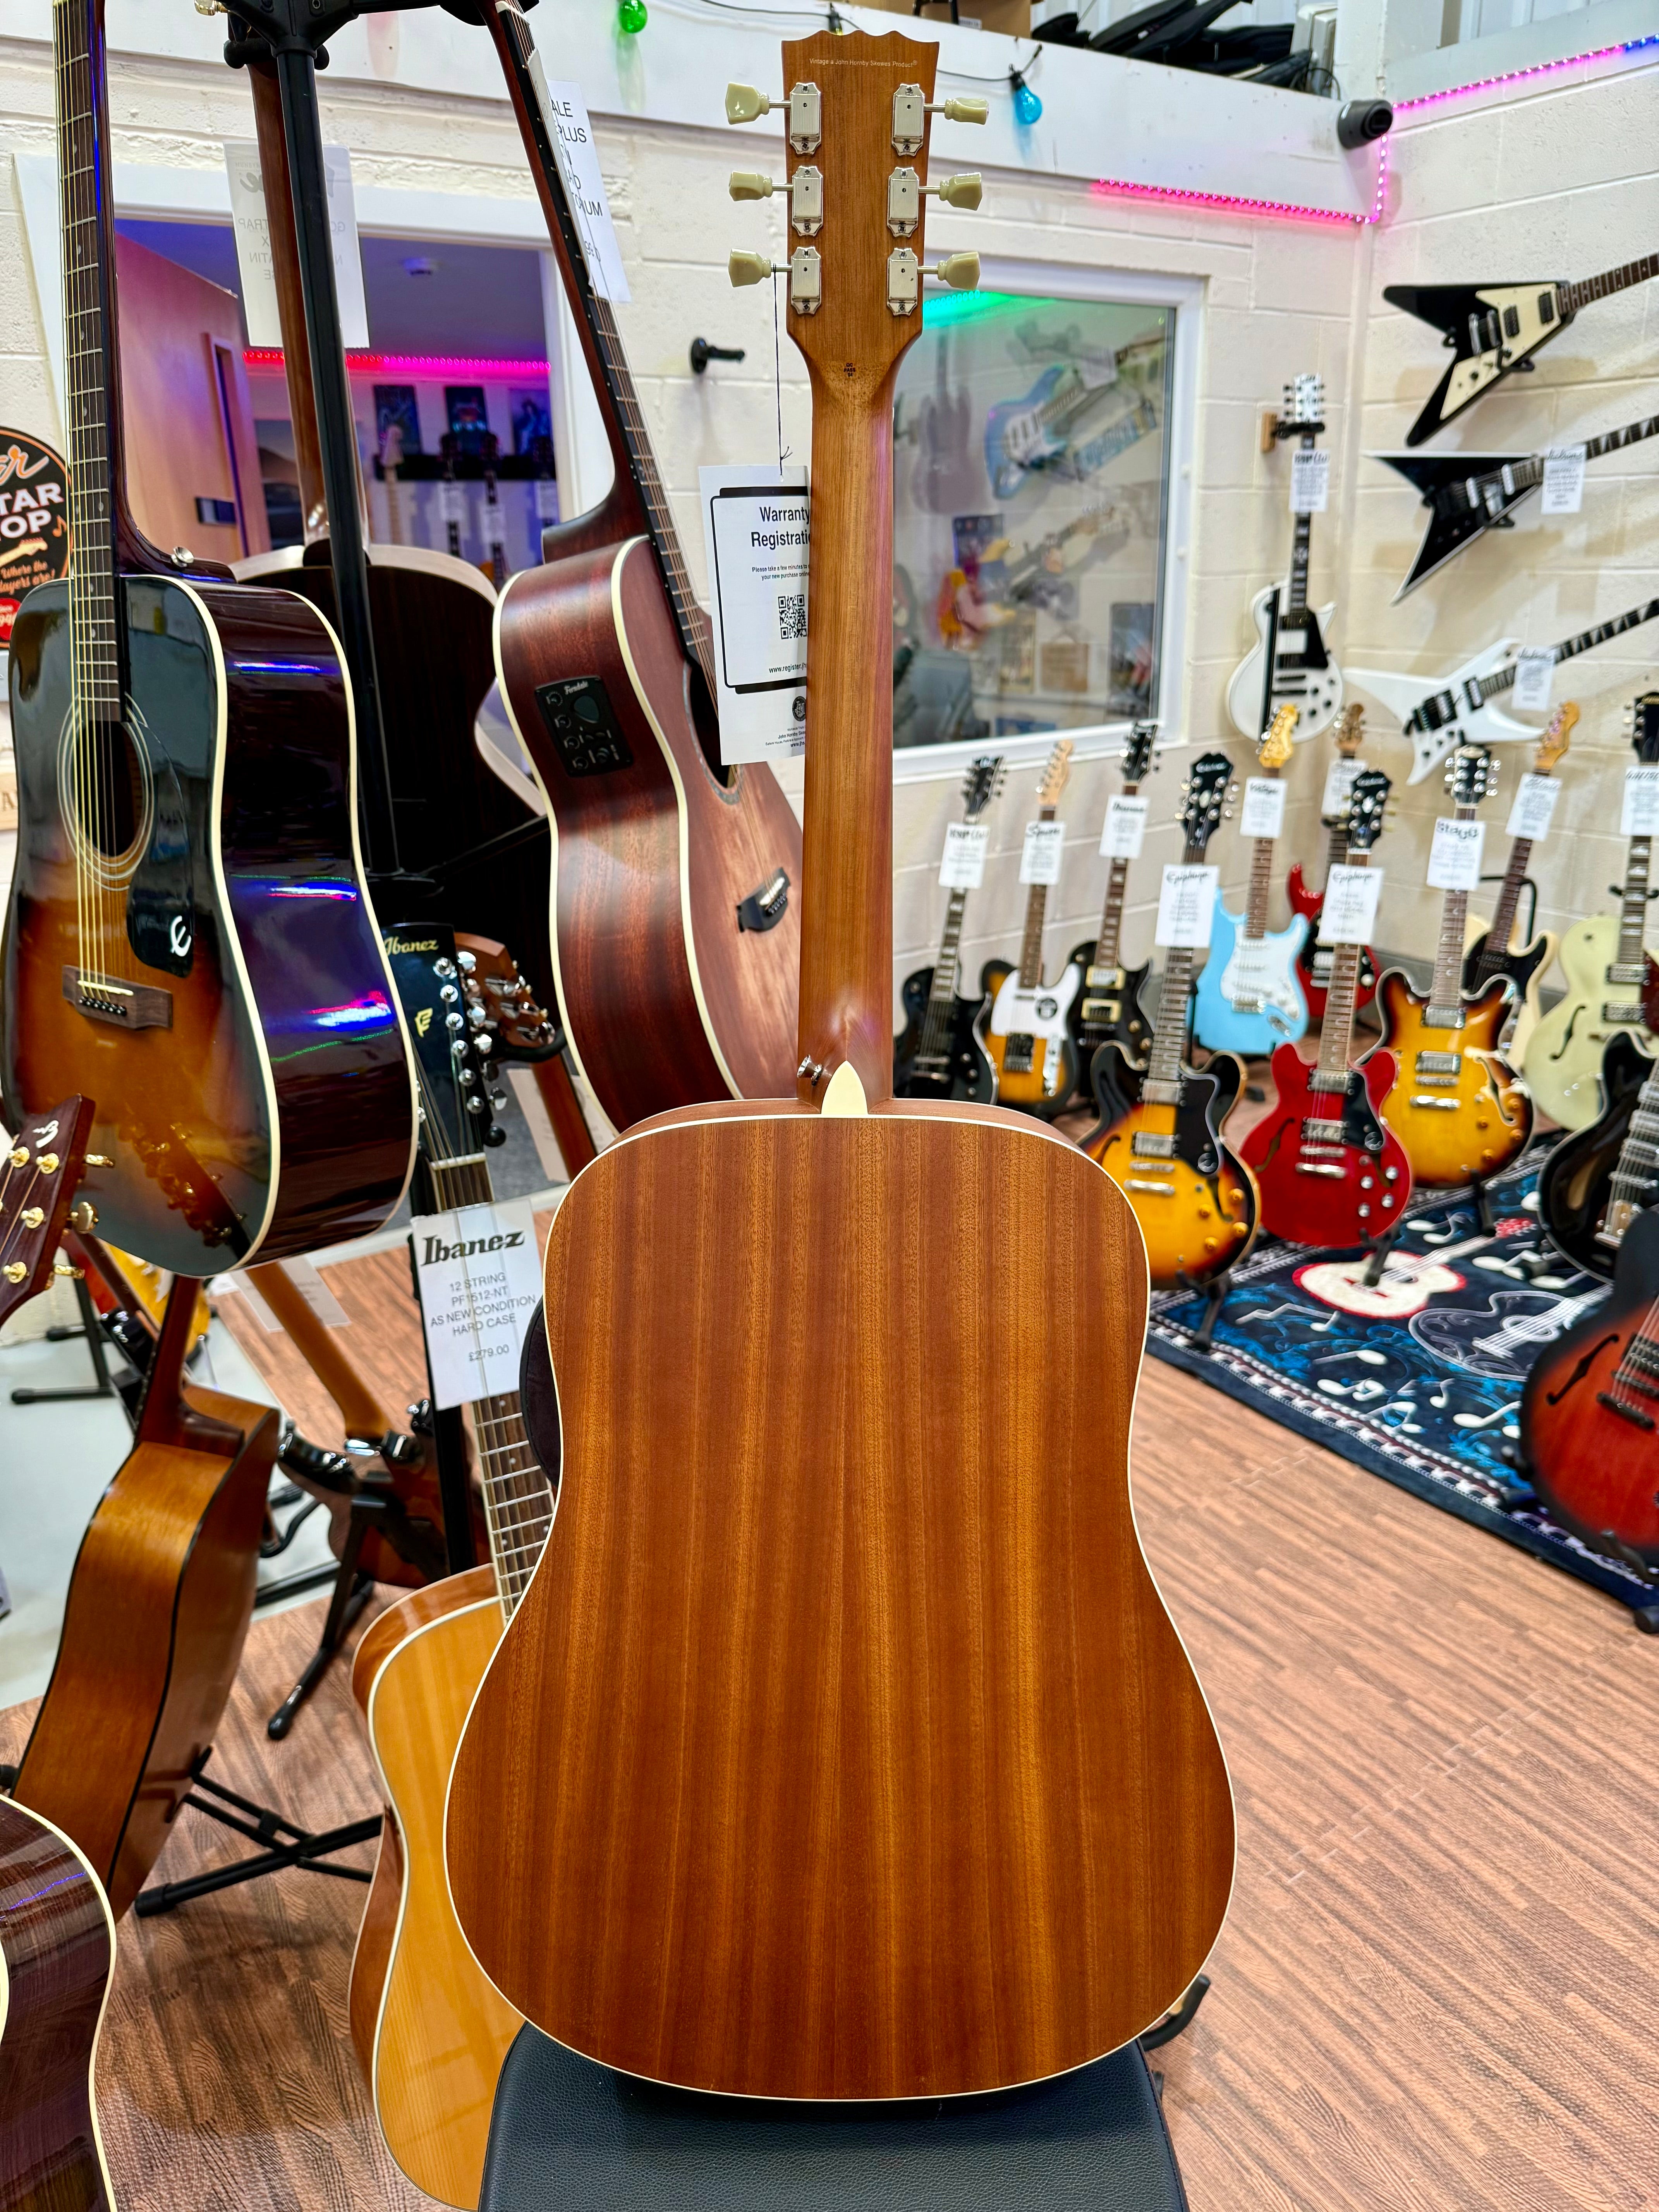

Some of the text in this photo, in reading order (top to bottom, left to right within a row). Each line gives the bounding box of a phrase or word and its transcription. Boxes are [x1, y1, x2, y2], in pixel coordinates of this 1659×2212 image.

[759, 507, 810, 524] Warranty
[769, 663, 807, 673] www.register.jh
[383, 936, 439, 957] Ibanez
[421, 1230, 525, 1267] Ibanez
[450, 1272, 506, 1292] 12 STRING
[431, 1294, 536, 1327] AS NEW CONDITION
[453, 1312, 516, 1336] HARD CASE
[469, 1344, 510, 1362] £279.00
